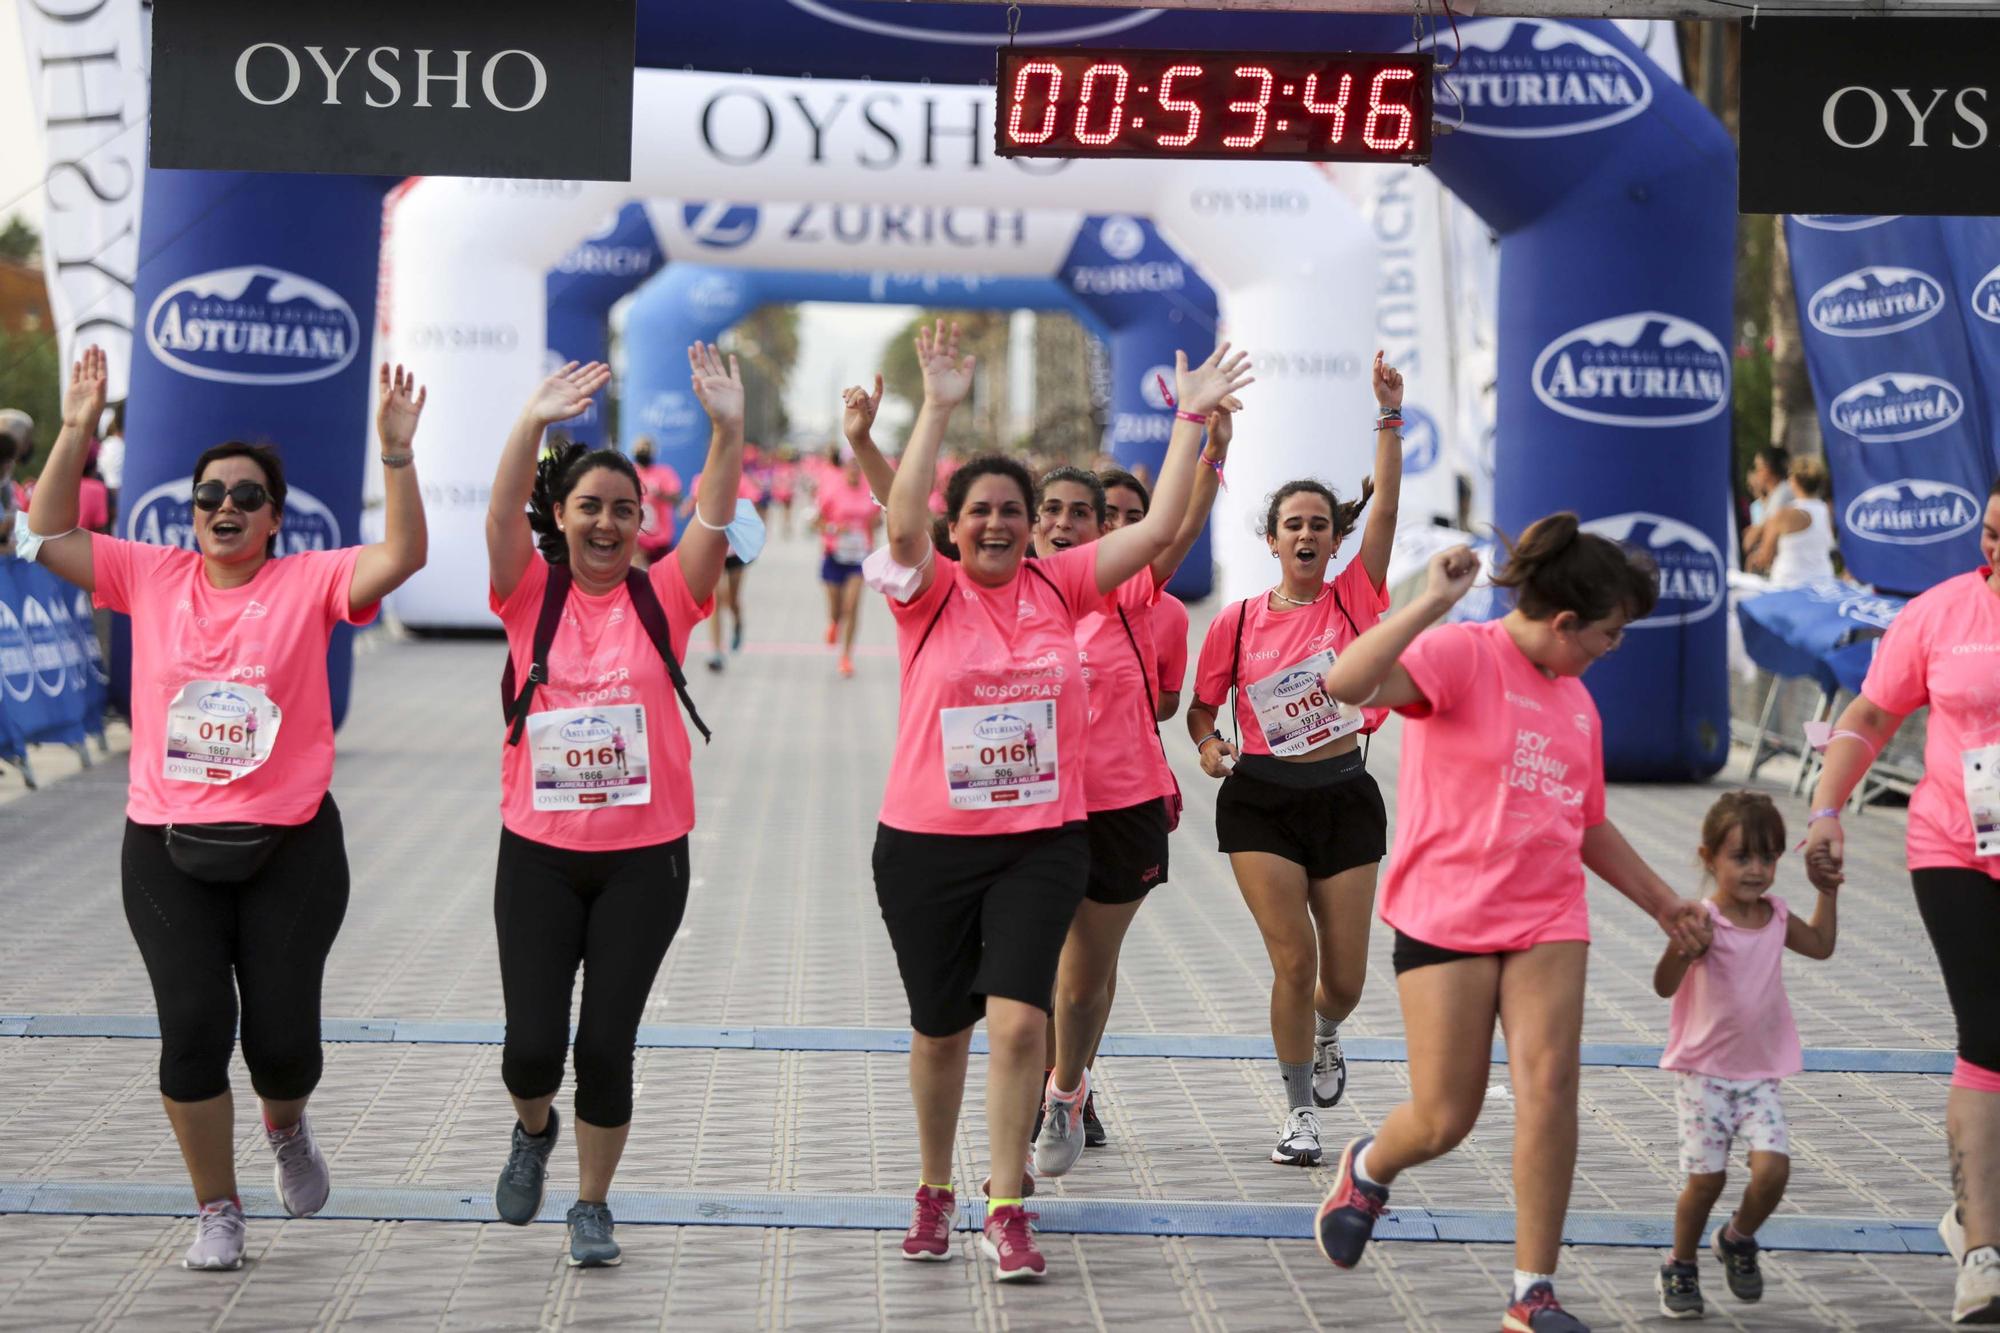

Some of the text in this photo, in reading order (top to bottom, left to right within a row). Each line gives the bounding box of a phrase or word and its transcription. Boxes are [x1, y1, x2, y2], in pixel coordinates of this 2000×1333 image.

[234, 42, 547, 112] OYSHO
[1434, 70, 1638, 106] STURIANA
[702, 84, 1076, 176] OYSH
[787, 203, 1026, 246] ZURICH
[158, 300, 346, 359] ASTURIANA
[232, 665, 266, 680] POR
[974, 684, 1062, 698] NOSOTRAS
[1277, 676, 1314, 695] ASTURIANA
[1286, 692, 1324, 718] 016
[1301, 712, 1321, 726] 1973
[200, 722, 243, 743] 016
[1516, 728, 1552, 753] HOY
[209, 745, 231, 757] 1867
[566, 748, 613, 767] 016
[980, 744, 1025, 765] 016
[995, 768, 1013, 778] 506
[1509, 768, 1537, 792] LAS
